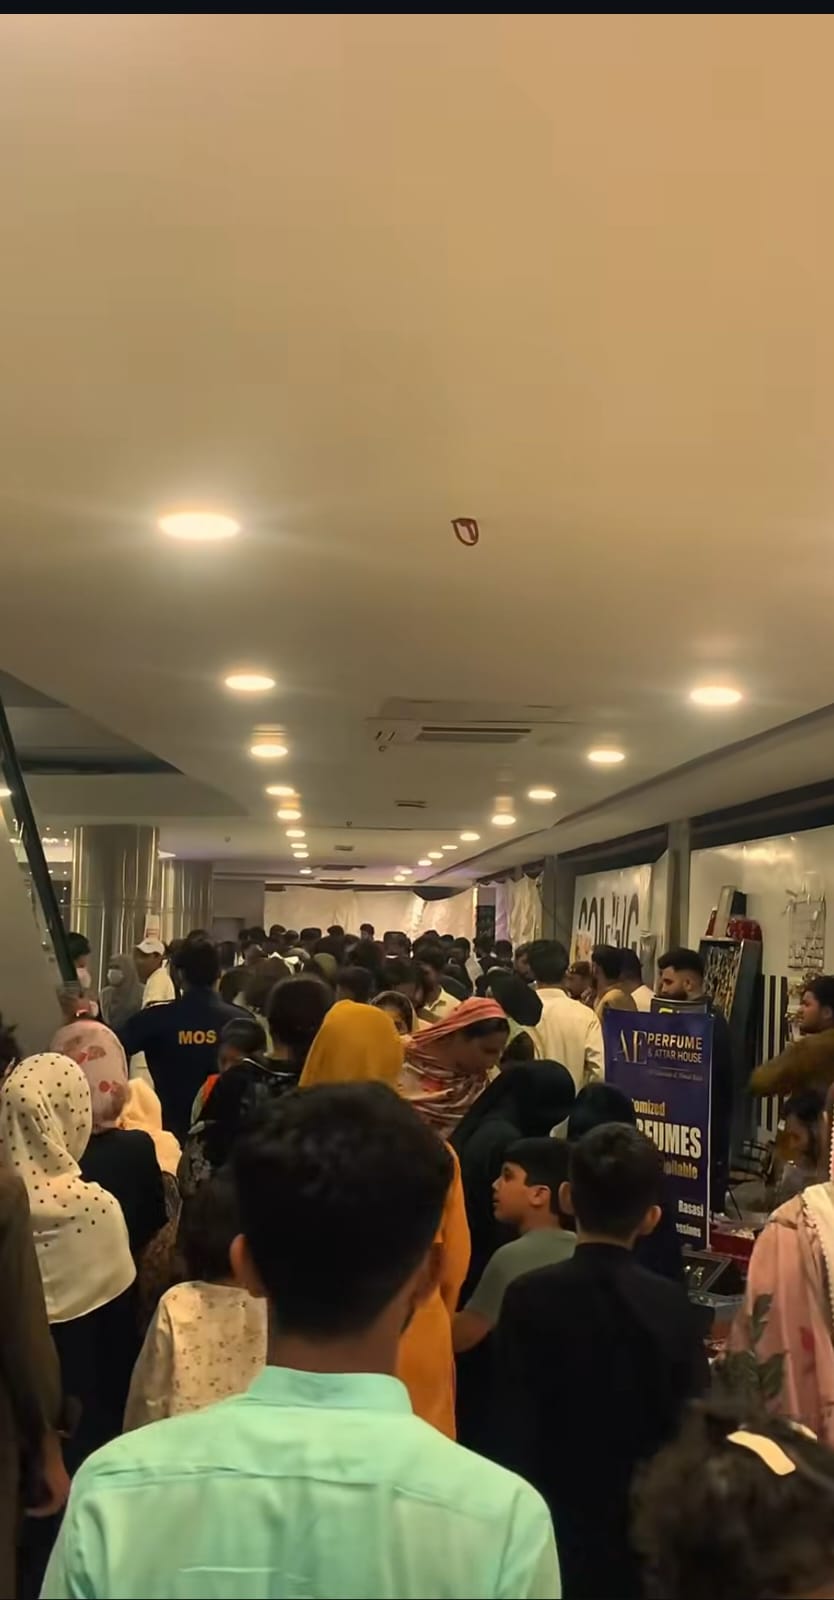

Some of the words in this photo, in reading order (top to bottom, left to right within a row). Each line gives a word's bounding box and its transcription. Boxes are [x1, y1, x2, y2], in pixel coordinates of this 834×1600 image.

[178, 1030, 217, 1045] MOS
[647, 1032, 703, 1050] PERFUME
[654, 1048, 677, 1060] ATTAR
[677, 1051, 703, 1064] HOUSE
